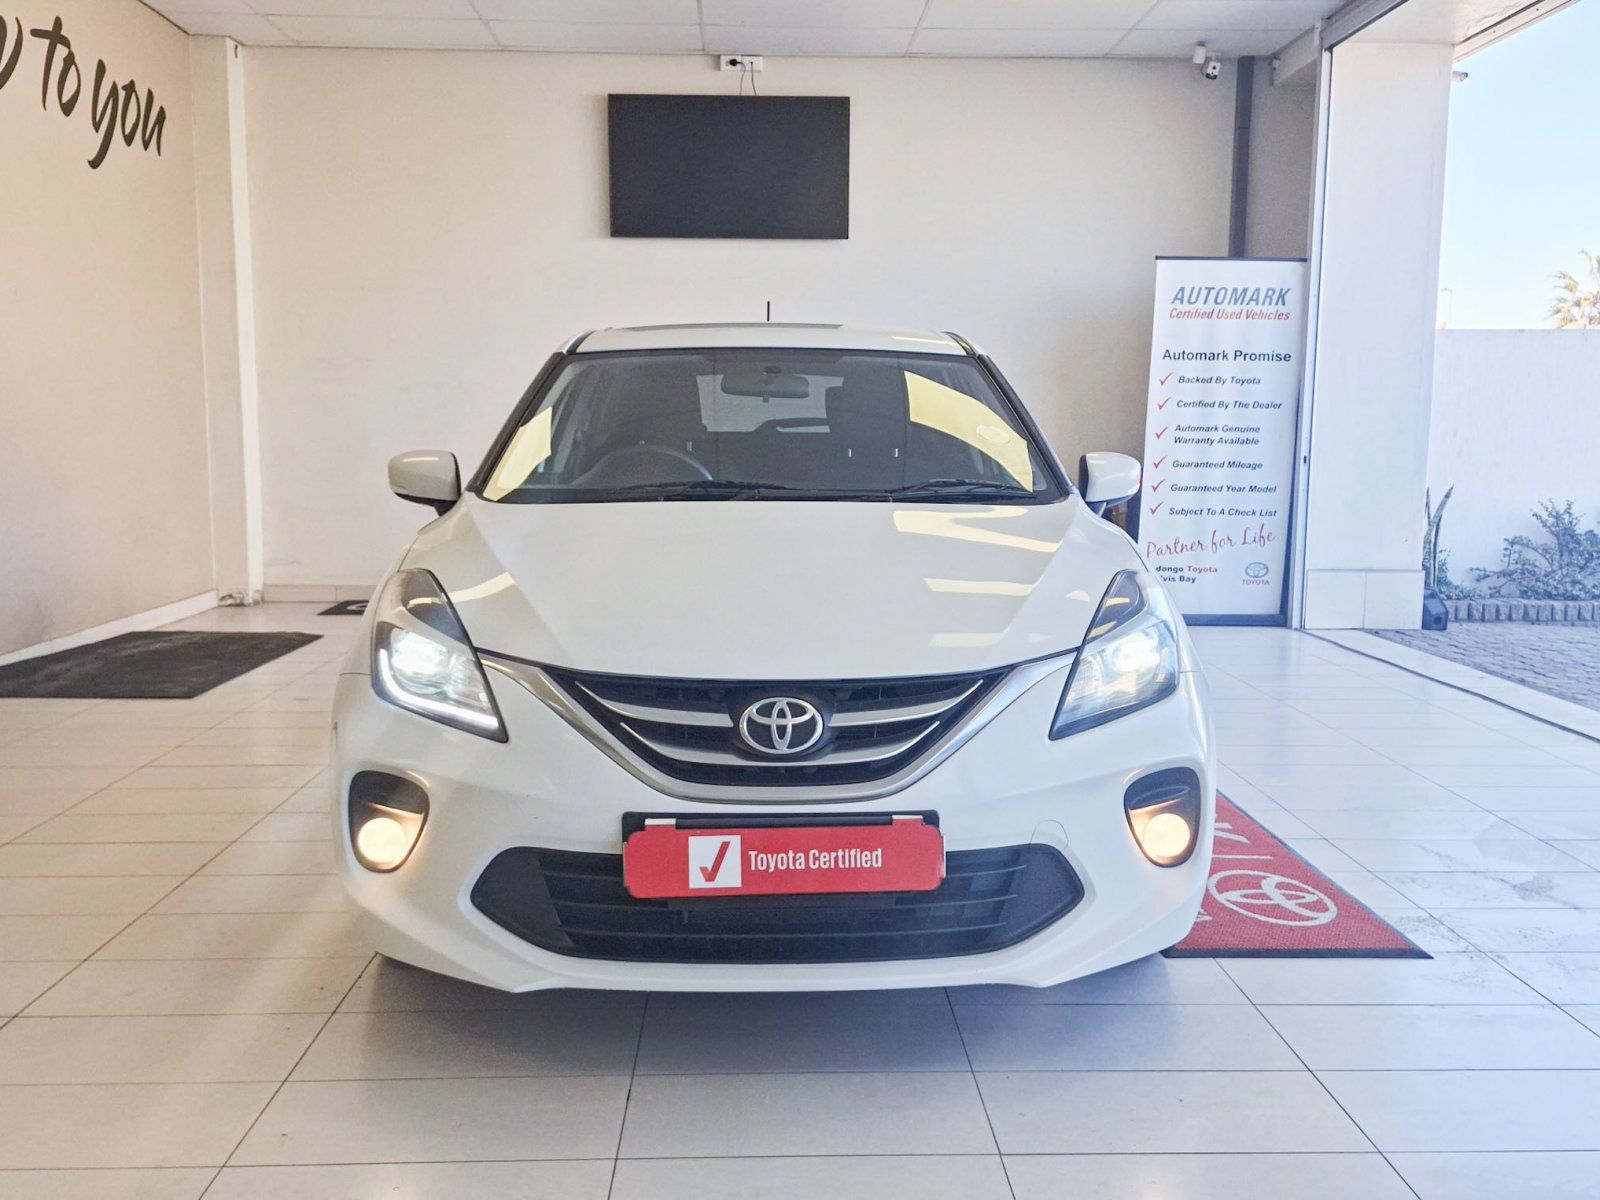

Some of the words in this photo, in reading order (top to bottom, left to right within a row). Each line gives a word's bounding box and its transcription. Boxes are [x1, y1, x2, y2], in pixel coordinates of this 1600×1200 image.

[30, 15, 82, 118] to
[87, 58, 166, 170] you
[1171, 286, 1292, 306] AUTOMARK
[1170, 308, 1214, 320] Certified
[1216, 308, 1242, 320] Used
[1246, 309, 1290, 320] Vehicles
[1162, 350, 1228, 361] Automark
[1234, 350, 1292, 362] Promise
[1178, 376, 1212, 384] Backed
[1215, 377, 1227, 386] By
[1230, 376, 1261, 386] Toyota
[1176, 400, 1216, 408] Certified
[1218, 400, 1229, 410] By
[1232, 400, 1250, 408] The
[1252, 400, 1283, 409] Dealer
[1174, 424, 1218, 433] Automark
[1222, 425, 1260, 433] Genuine
[1174, 437, 1214, 446] Warranty
[1217, 437, 1260, 445] Available
[1172, 460, 1225, 469] Guaranteed
[1227, 460, 1263, 470] Mileage
[1170, 484, 1223, 492] Guaranteed
[1226, 484, 1246, 492] Year
[1248, 485, 1277, 493] Model
[1169, 507, 1203, 517] Subject
[1259, 509, 1277, 517] List
[1146, 537, 1207, 558] Partner
[1210, 530, 1237, 554] for
[1242, 522, 1276, 548] Life
[1179, 576, 1196, 584] Bay
[748, 850, 805, 872] Toyota
[809, 848, 882, 870] Certified
